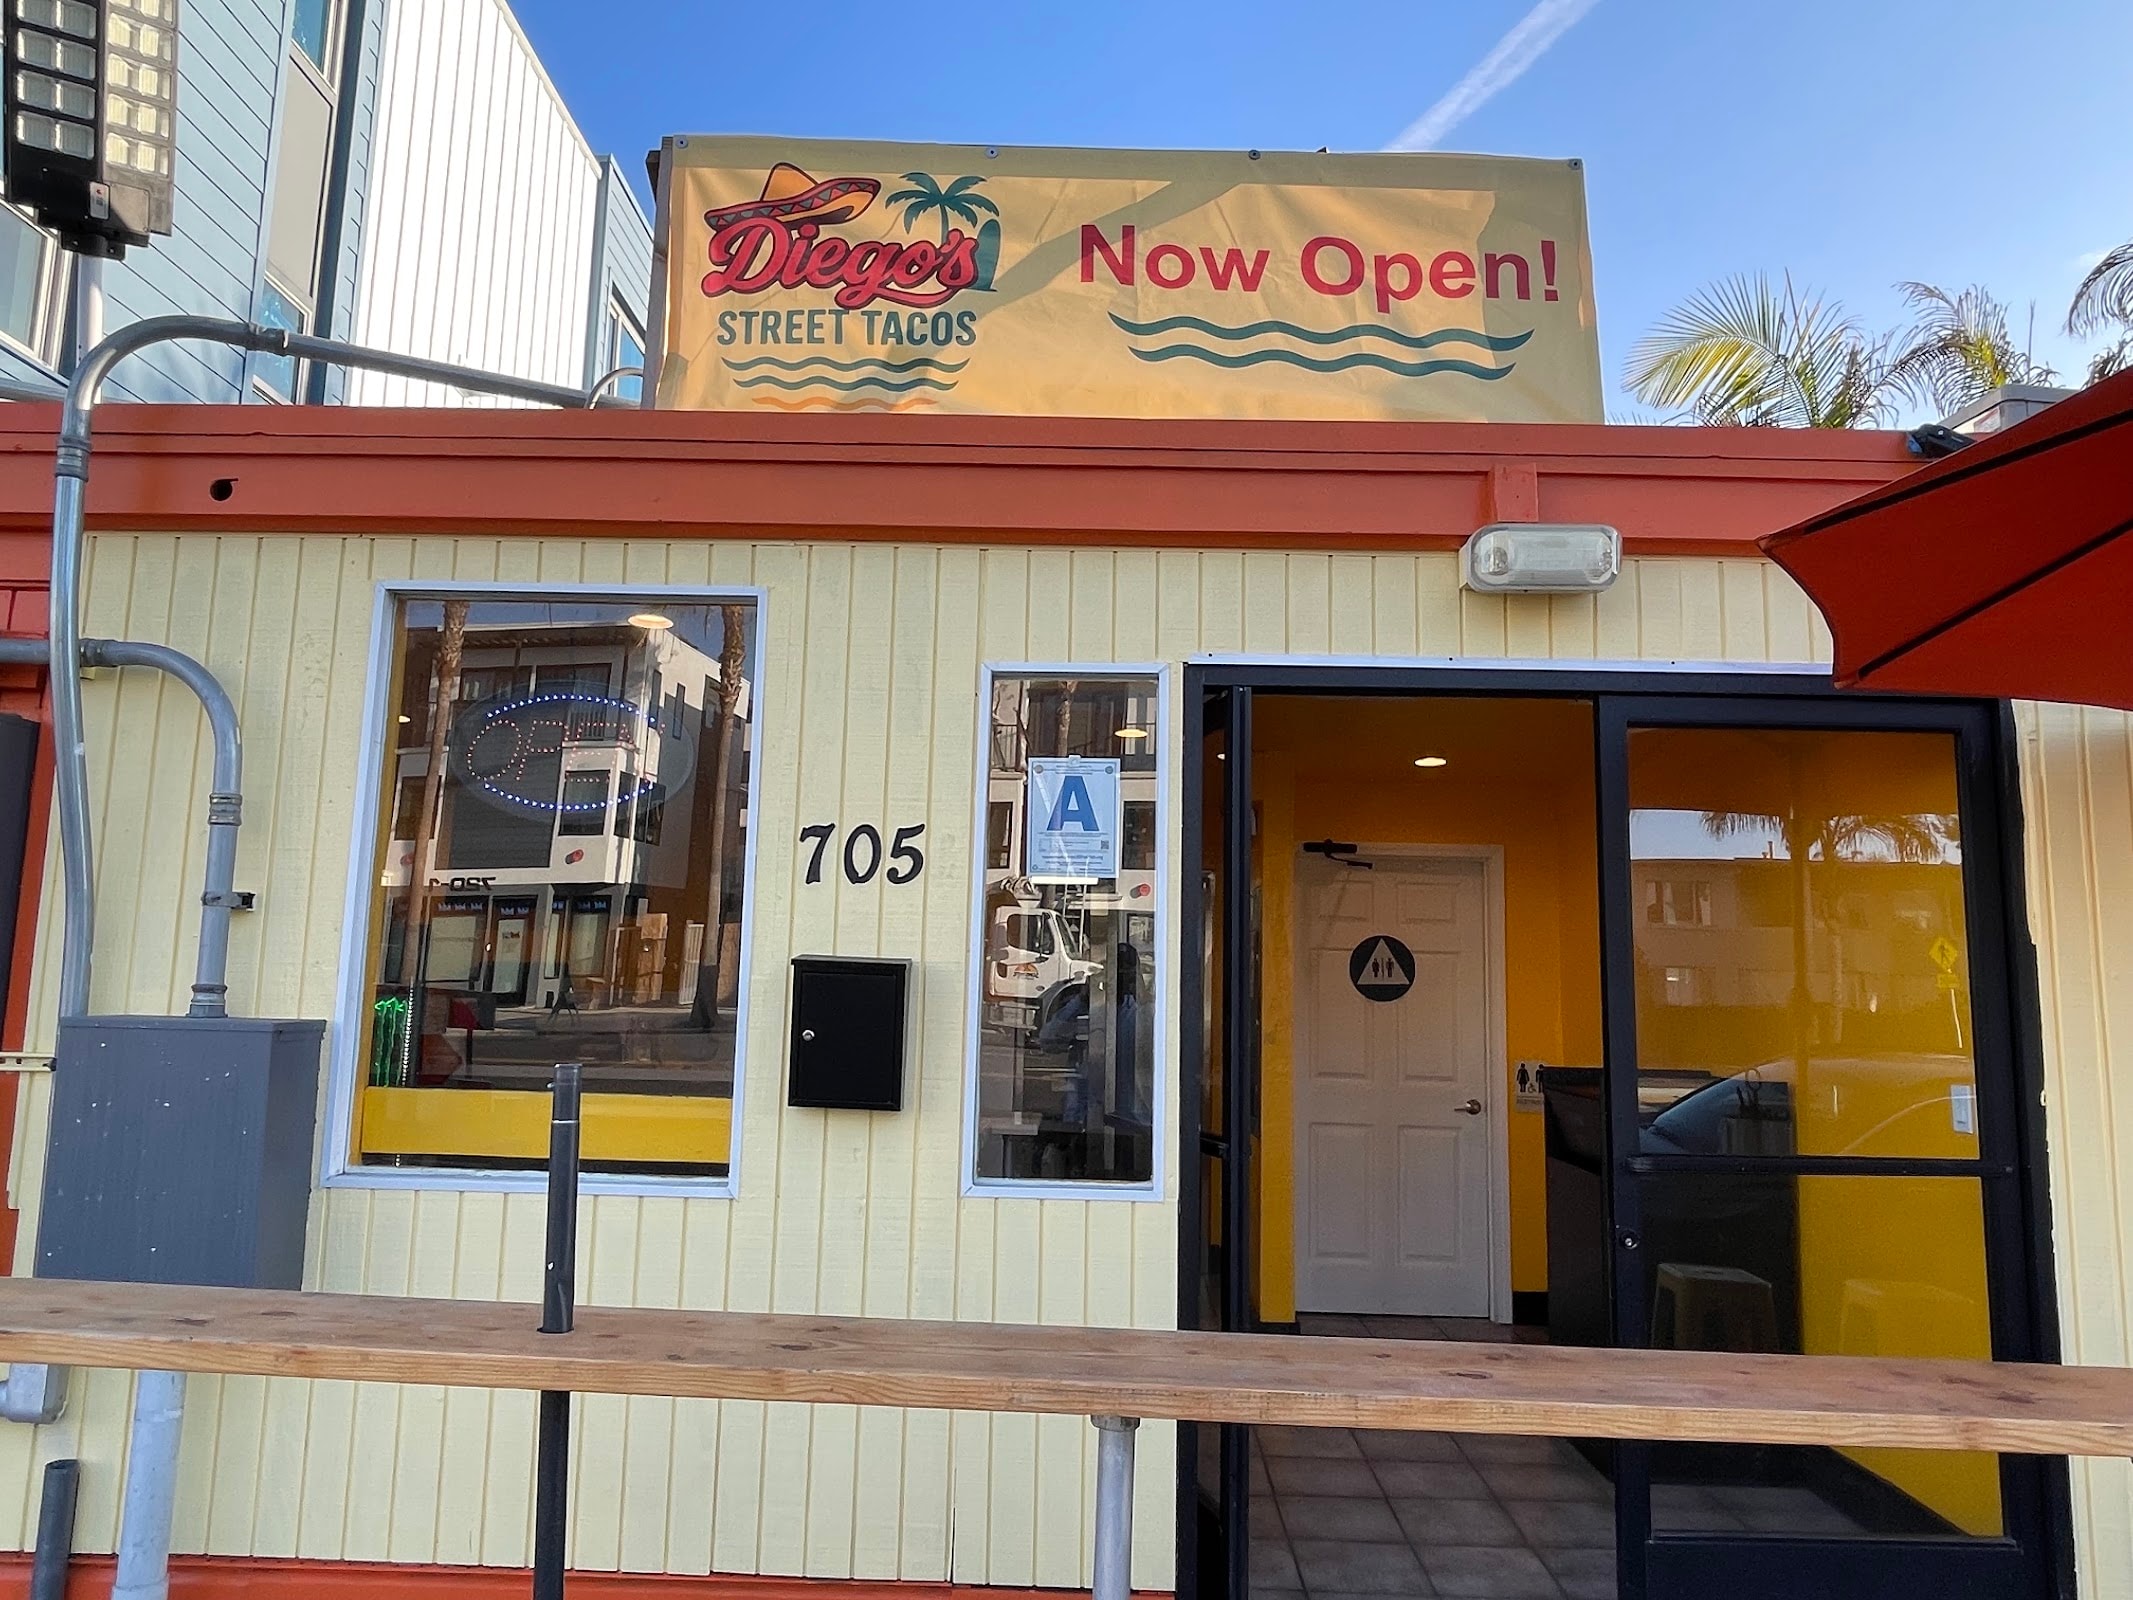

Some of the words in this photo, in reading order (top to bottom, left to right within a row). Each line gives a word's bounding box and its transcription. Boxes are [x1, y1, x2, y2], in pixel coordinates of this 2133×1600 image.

[701, 215, 979, 310] Diego's
[1080, 224, 1270, 293] Now
[1301, 236, 1559, 315] Open!
[717, 309, 850, 346] STREET
[861, 310, 977, 346] TACOS
[1046, 775, 1100, 832] A
[799, 823, 925, 884] 705
